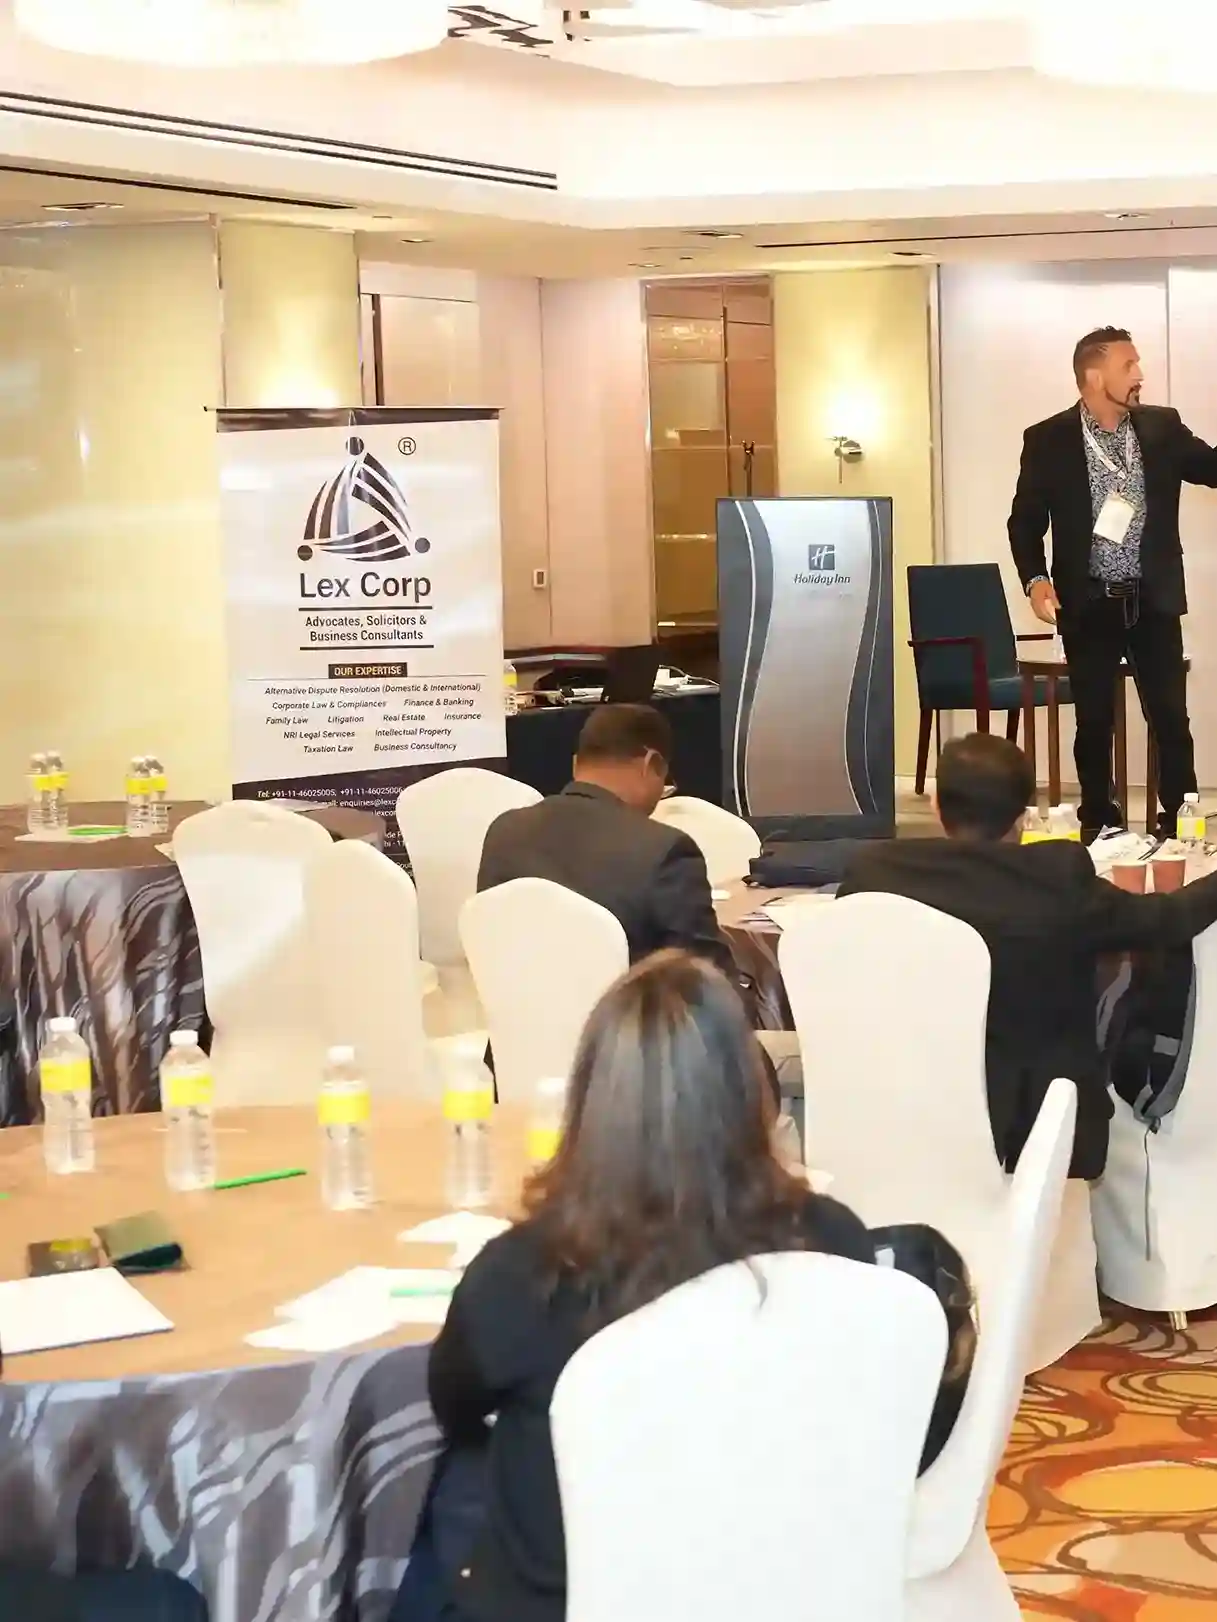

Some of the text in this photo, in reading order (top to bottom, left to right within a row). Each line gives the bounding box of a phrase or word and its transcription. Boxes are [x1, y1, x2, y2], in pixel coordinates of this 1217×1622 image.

[794, 573, 851, 586] Holiday Inn
[300, 571, 431, 602] Lex Corp
[305, 614, 428, 629] Advocates, Solicitors &
[310, 629, 424, 643] Business Consultants
[334, 665, 403, 677] OUR EXPERTISE
[264, 687, 307, 696] Alternative
[308, 686, 338, 697] Dispute
[339, 685, 381, 695] Resolution
[382, 684, 421, 694] (Domestic
[430, 683, 482, 693] International)
[272, 701, 311, 711] Corporate
[311, 701, 328, 710] Law
[337, 699, 387, 710] Compliances
[404, 698, 434, 707] Finance
[443, 697, 475, 708] Banking
[265, 716, 309, 726] Family Law
[327, 714, 365, 725] Litigation
[383, 712, 426, 722] Real Estate
[444, 712, 482, 721] Insurance
[284, 729, 356, 740] NRI Legal Services
[375, 727, 452, 738] Intellectual Property
[304, 744, 354, 754] Taxation Law
[374, 741, 457, 752] Business Consultancy
